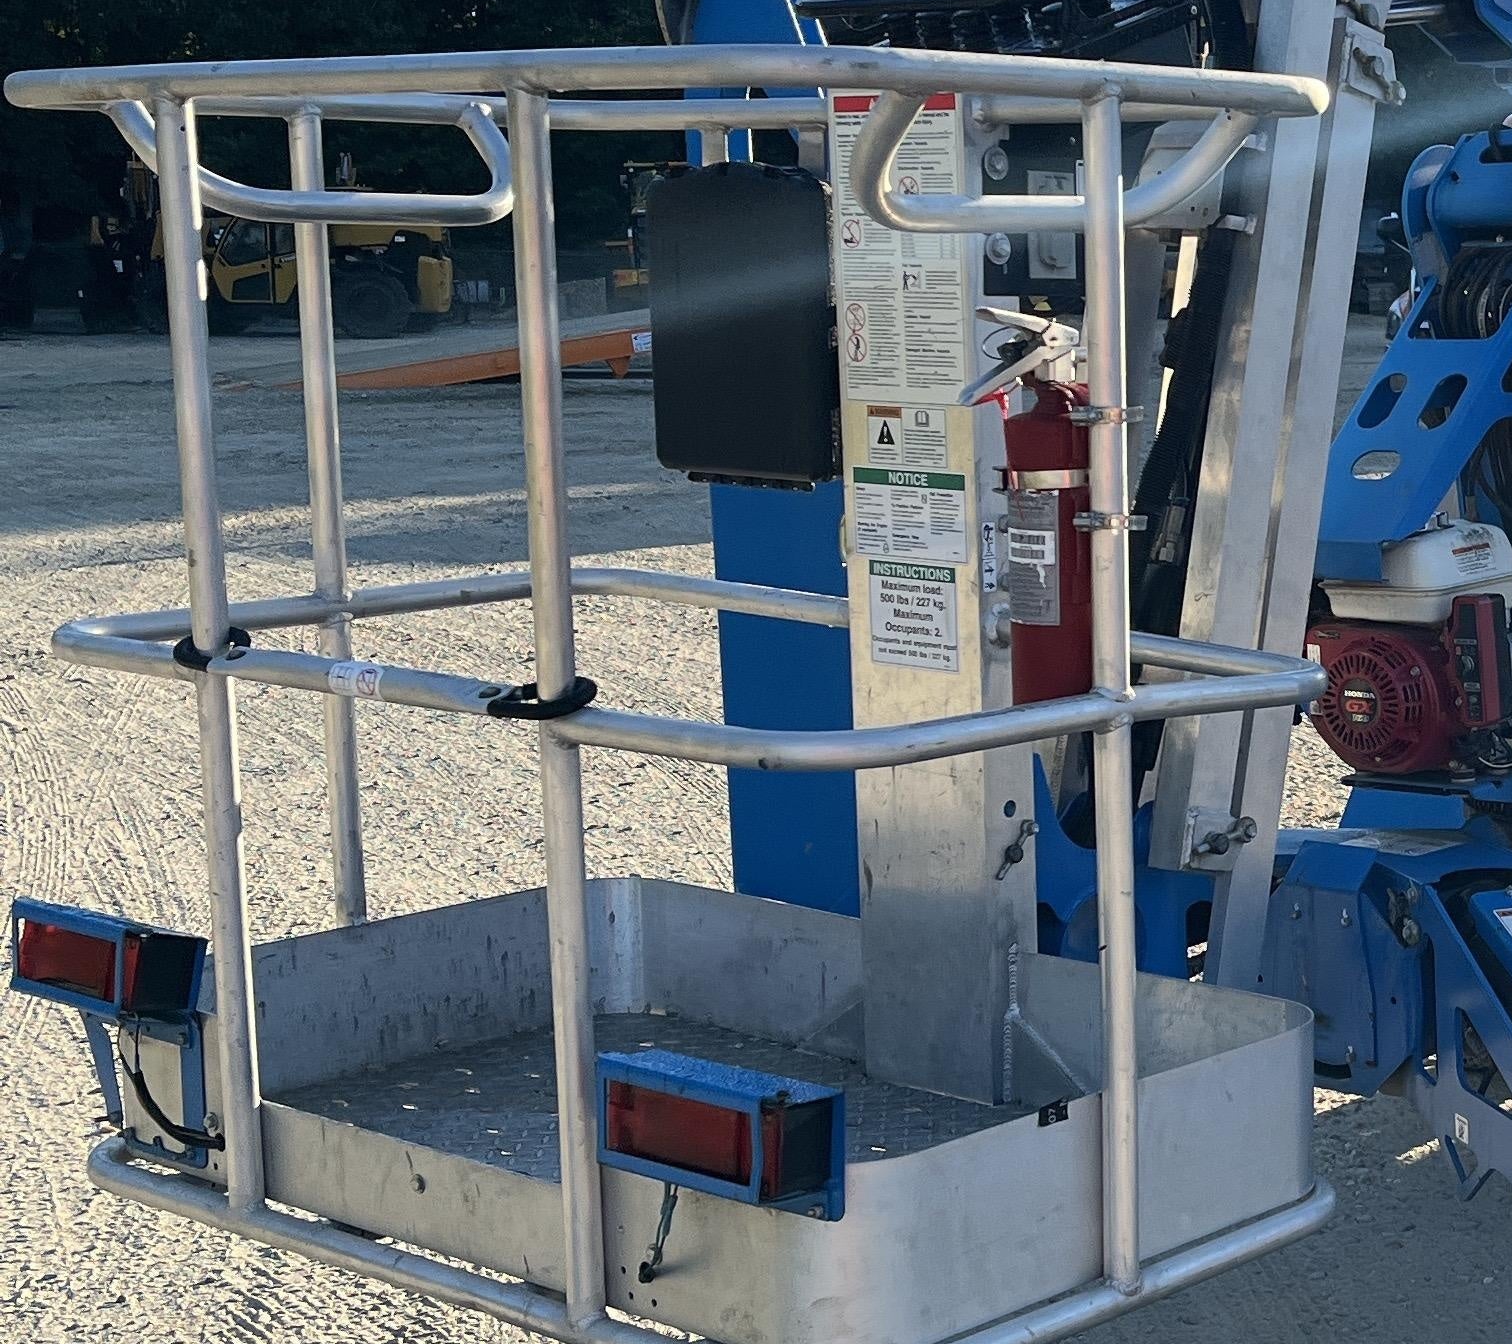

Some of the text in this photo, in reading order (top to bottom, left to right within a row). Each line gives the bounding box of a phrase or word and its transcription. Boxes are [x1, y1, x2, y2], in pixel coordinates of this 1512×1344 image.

[888, 471, 929, 487] NOTICE
[873, 561, 951, 582] INSTRUCTIONS
[881, 580, 943, 595] Maximum load:
[880, 593, 895, 603] 500
[897, 594, 909, 605] lbs
[916, 597, 931, 607] 227
[893, 608, 934, 622] Maximum
[885, 621, 933, 636] Occupants:
[1344, 689, 1376, 699] HONDA
